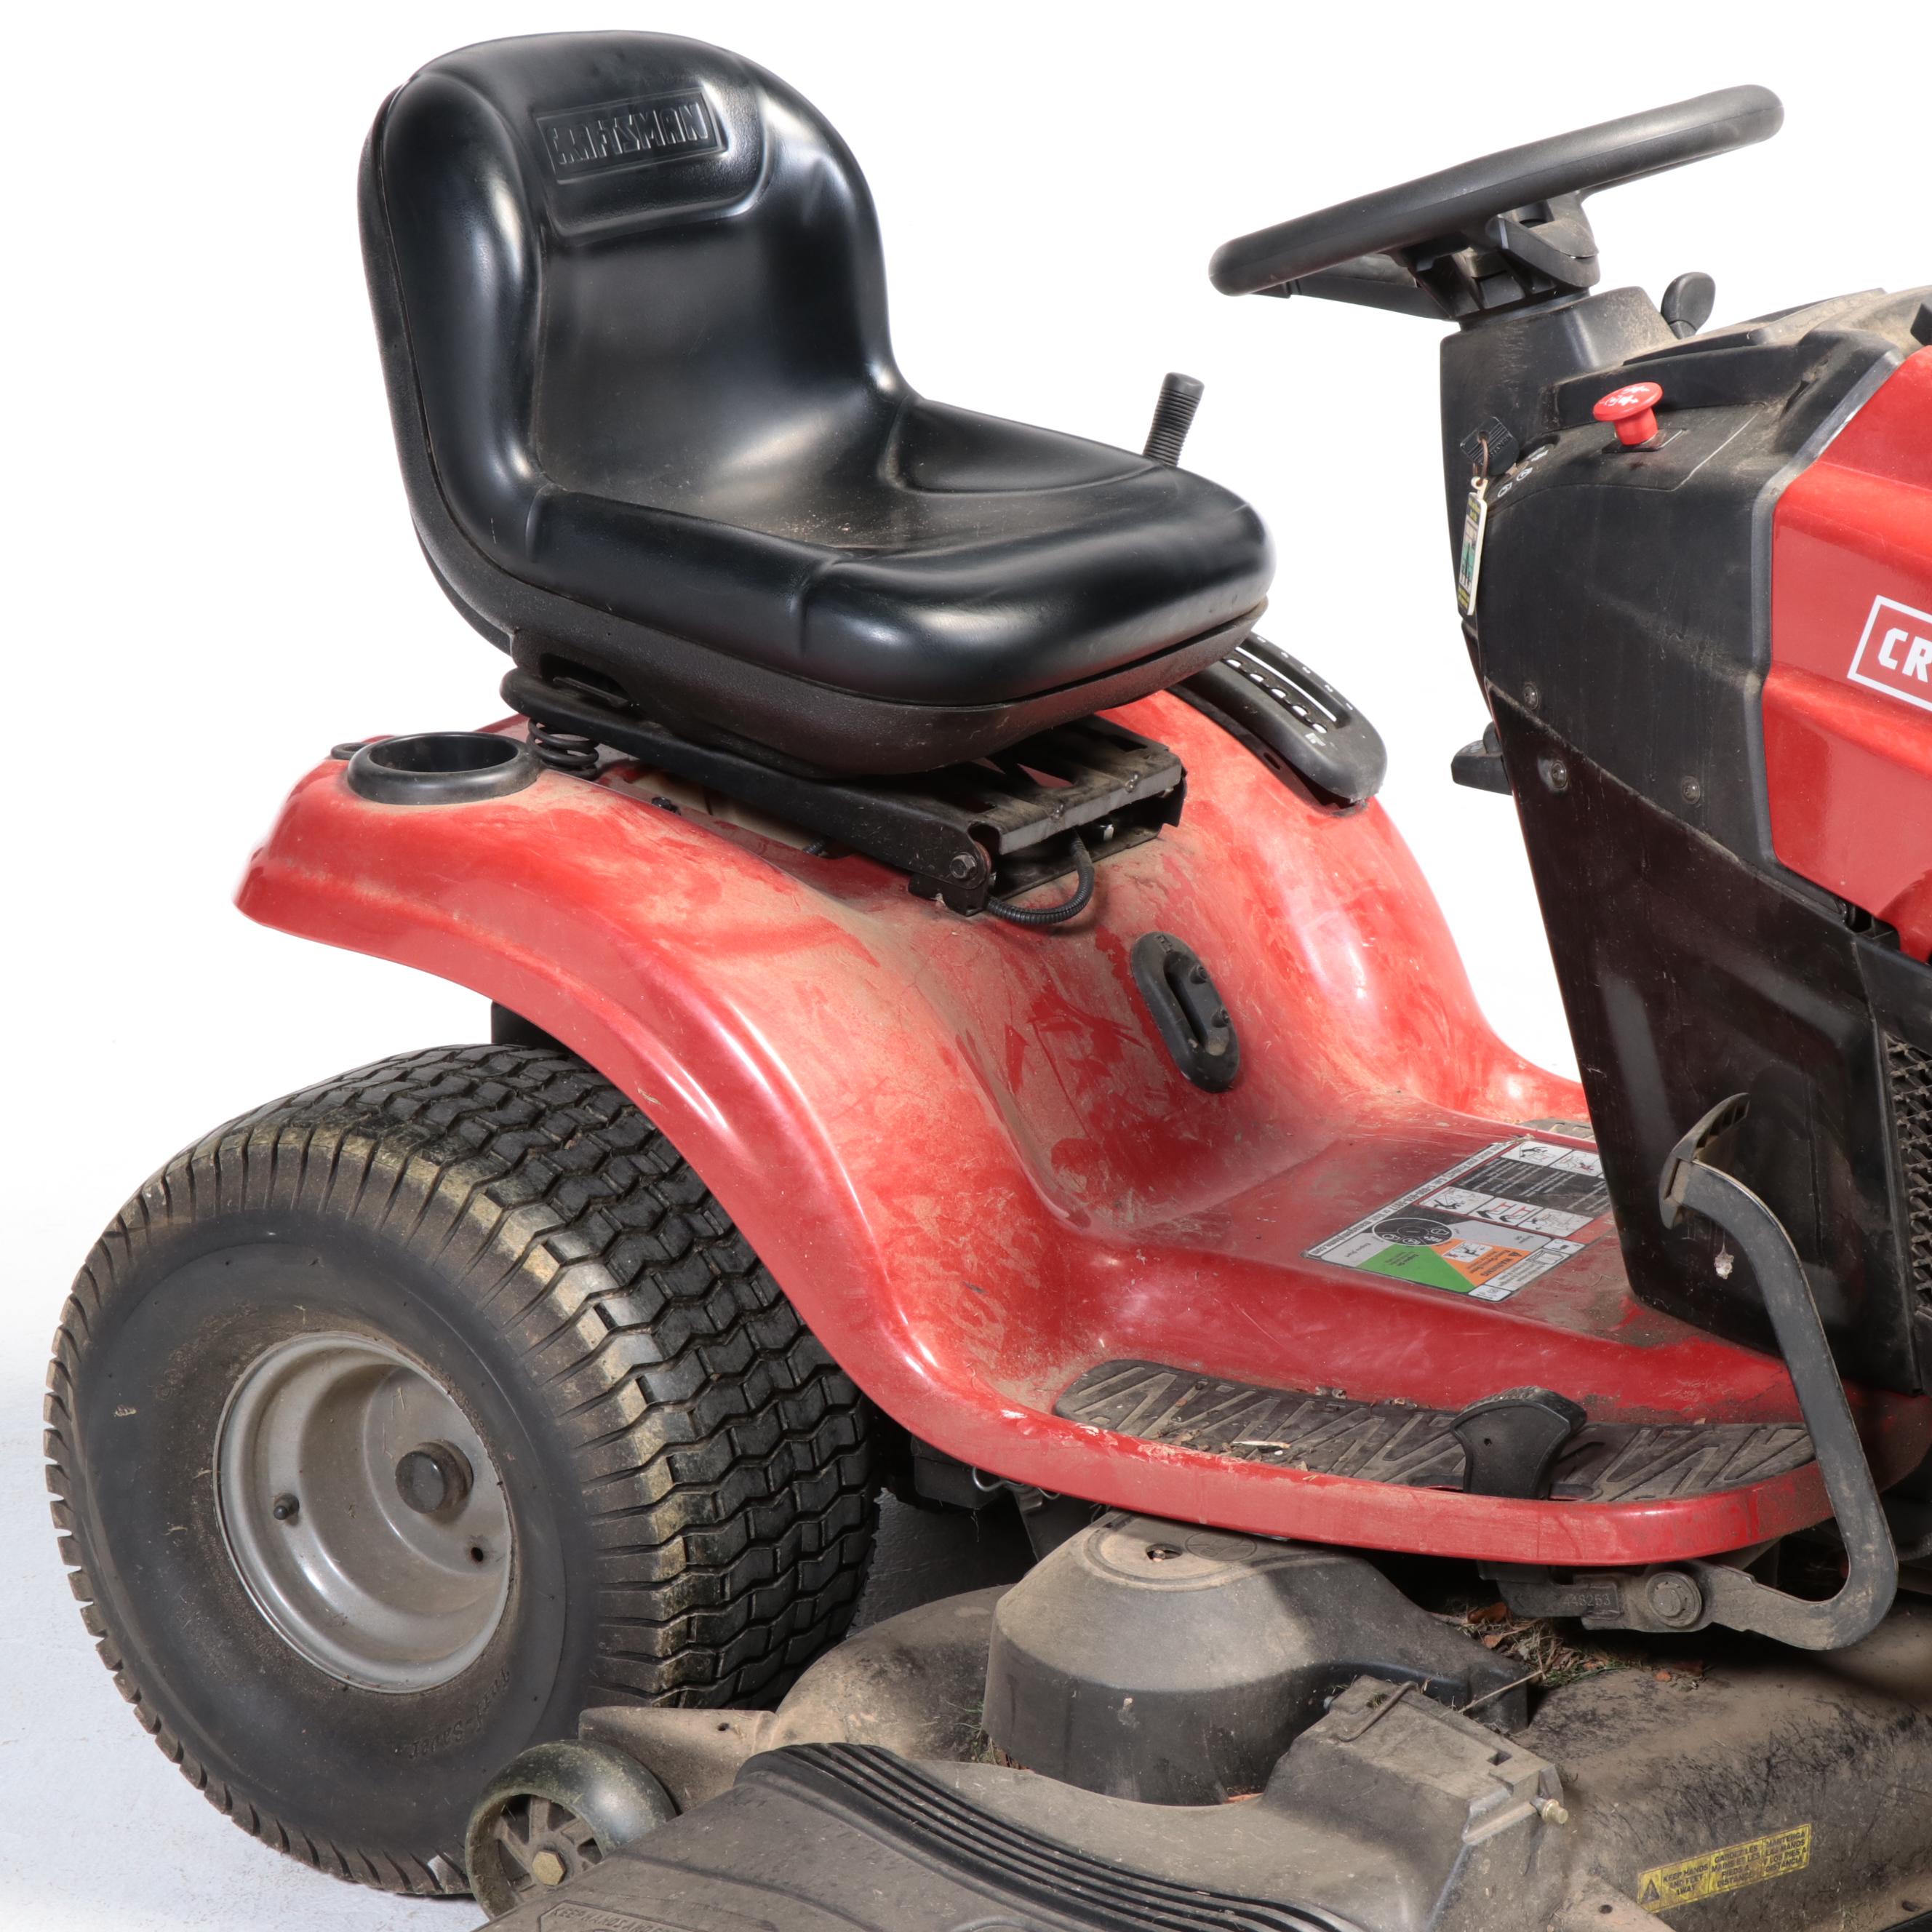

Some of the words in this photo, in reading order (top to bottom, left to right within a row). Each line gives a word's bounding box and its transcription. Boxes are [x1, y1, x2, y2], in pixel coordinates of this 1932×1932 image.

[551, 101, 709, 165] CRAFTSMAN
[1477, 1257, 1514, 1277] WARNING
[1767, 1831, 1805, 1847] MANTENGA
[1780, 1839, 1805, 1853] MANOS
[1748, 1852, 1760, 1864] LES
[1765, 1856, 1803, 1872] DISTANCIA
[1664, 1871, 1682, 1882] KEEP
[1683, 1864, 1708, 1877] HANDS
[1670, 1880, 1685, 1889] AND
[1686, 1874, 1703, 1885] FEET
